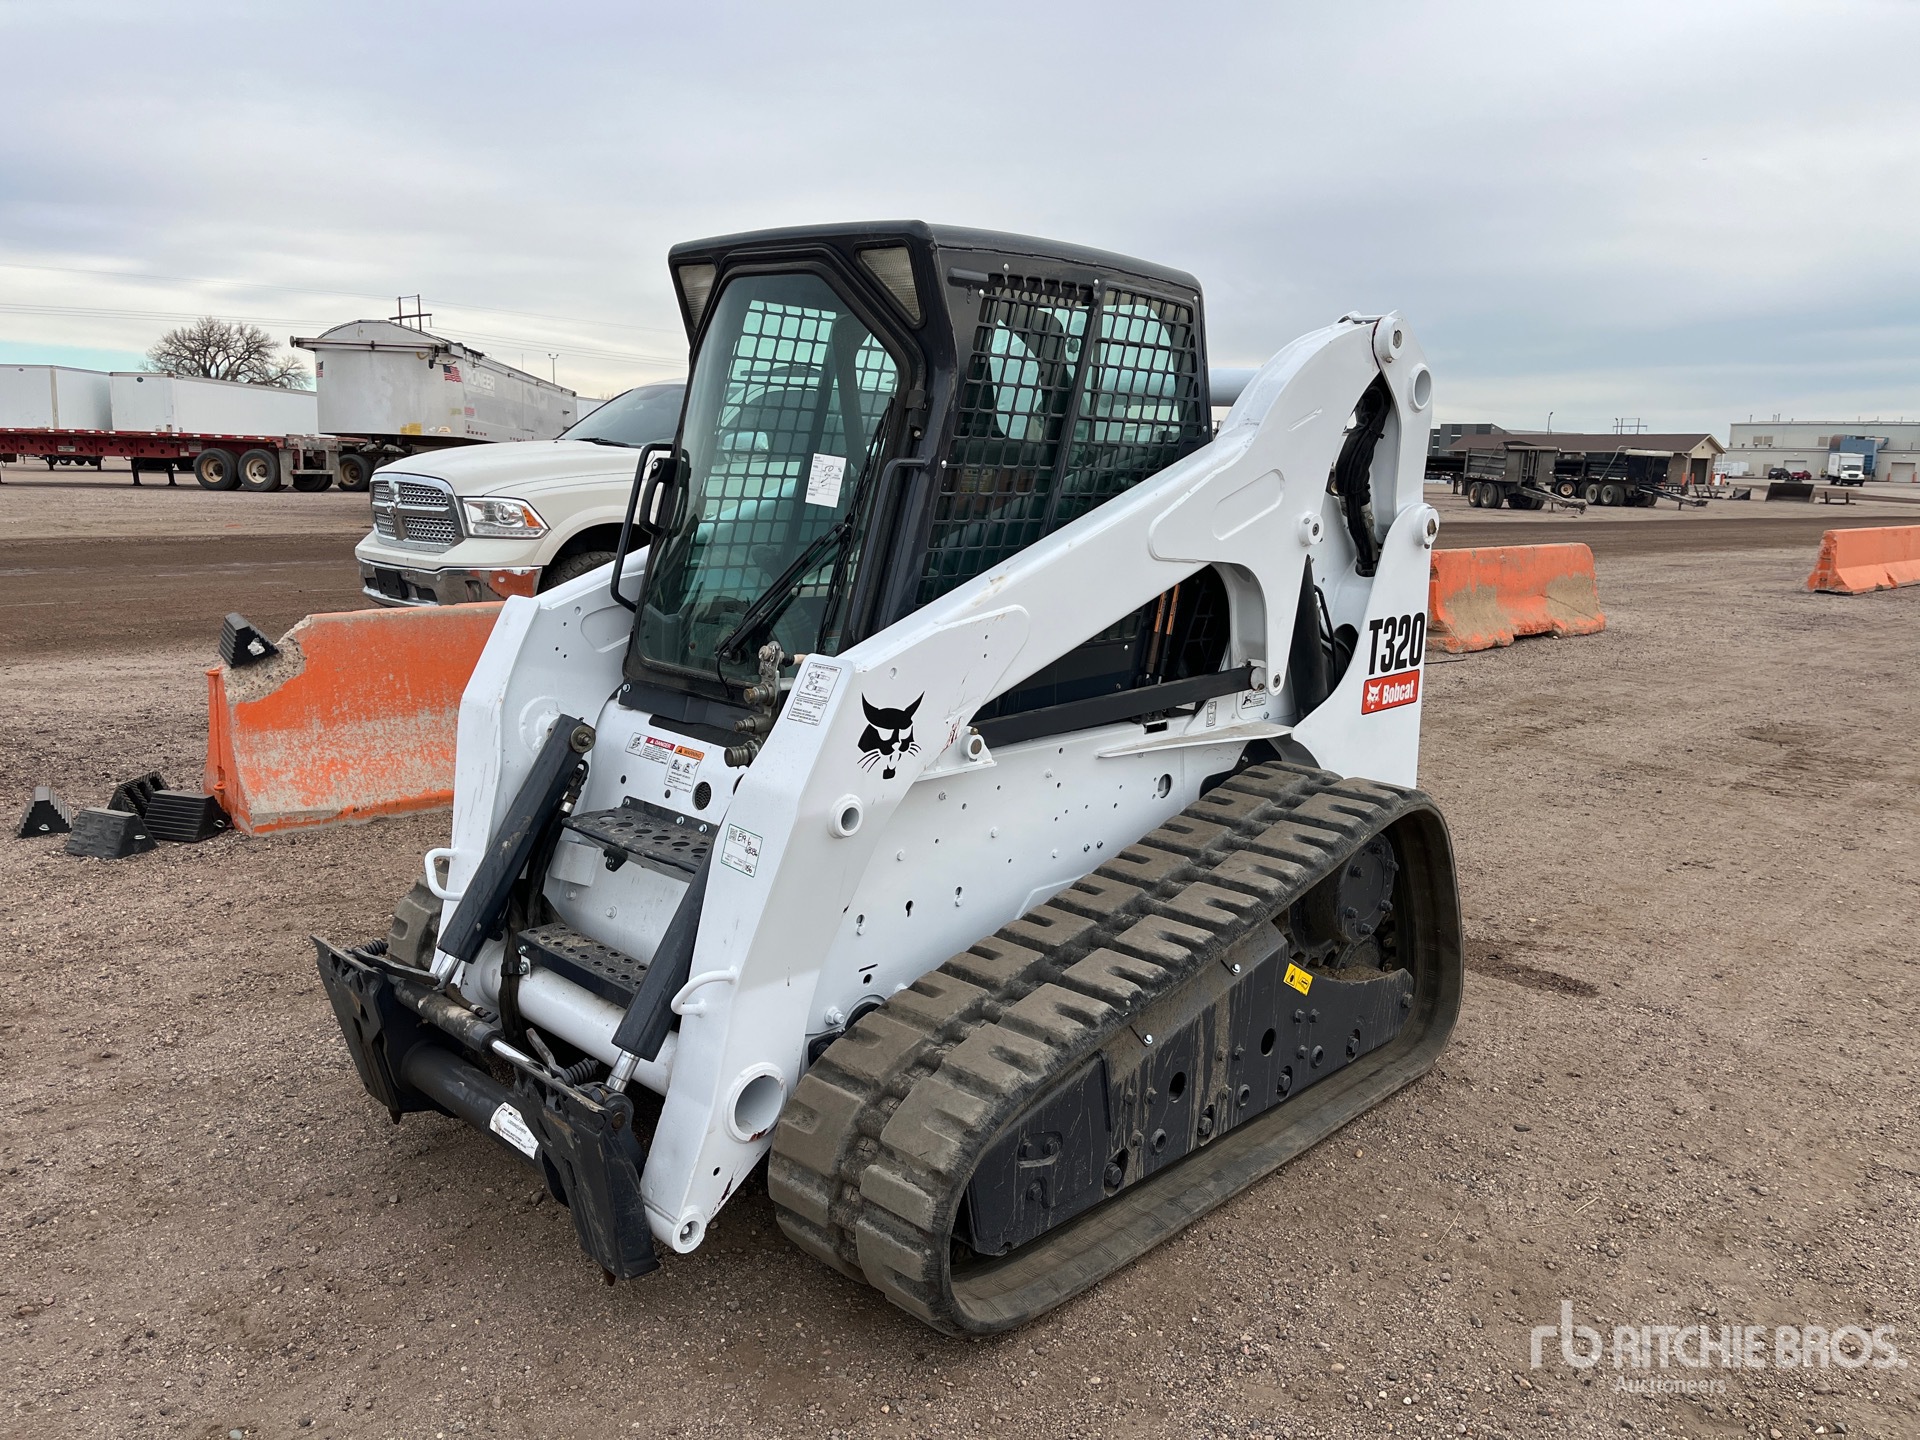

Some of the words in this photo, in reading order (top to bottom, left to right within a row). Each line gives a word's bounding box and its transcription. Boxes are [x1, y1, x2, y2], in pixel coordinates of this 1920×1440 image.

[1368, 612, 1426, 676] T320
[1382, 680, 1415, 705] Bobcat
[654, 740, 672, 749] DANGER
[684, 750, 702, 759] WARNING
